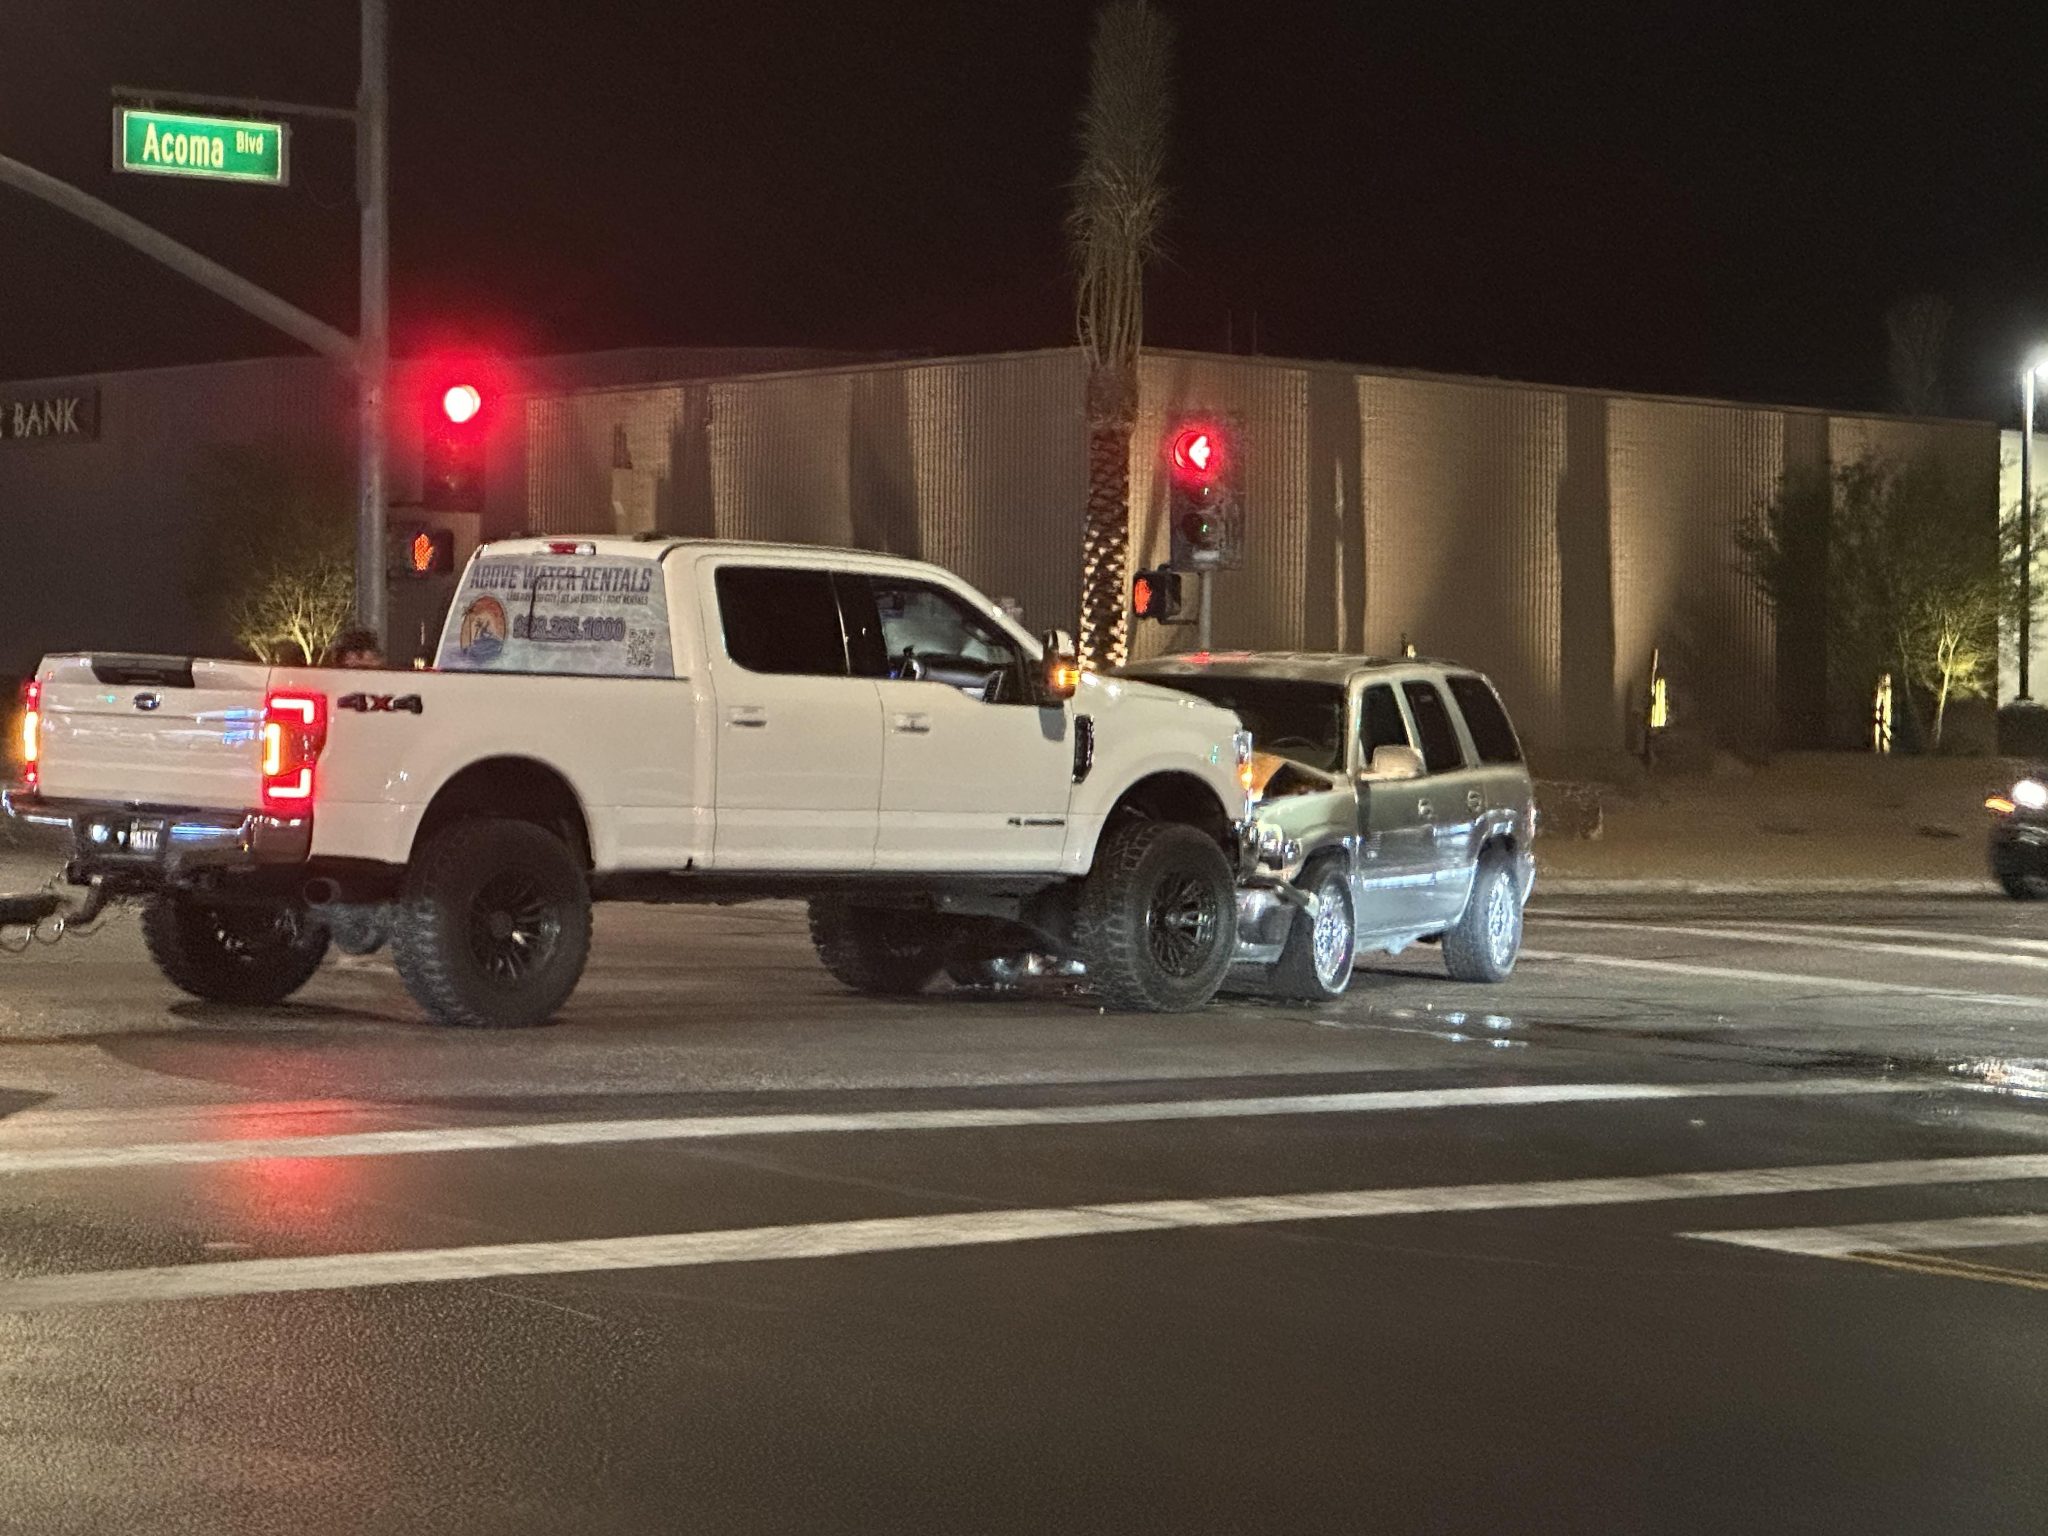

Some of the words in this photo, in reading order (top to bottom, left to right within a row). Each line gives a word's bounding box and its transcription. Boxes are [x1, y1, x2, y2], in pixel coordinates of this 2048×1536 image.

[142, 121, 225, 169] Acoma
[235, 130, 264, 155] Blvd
[13, 397, 80, 438] BANK
[470, 564, 521, 589] ABOVE
[522, 565, 577, 591] WATER
[580, 565, 653, 593] RENTALS
